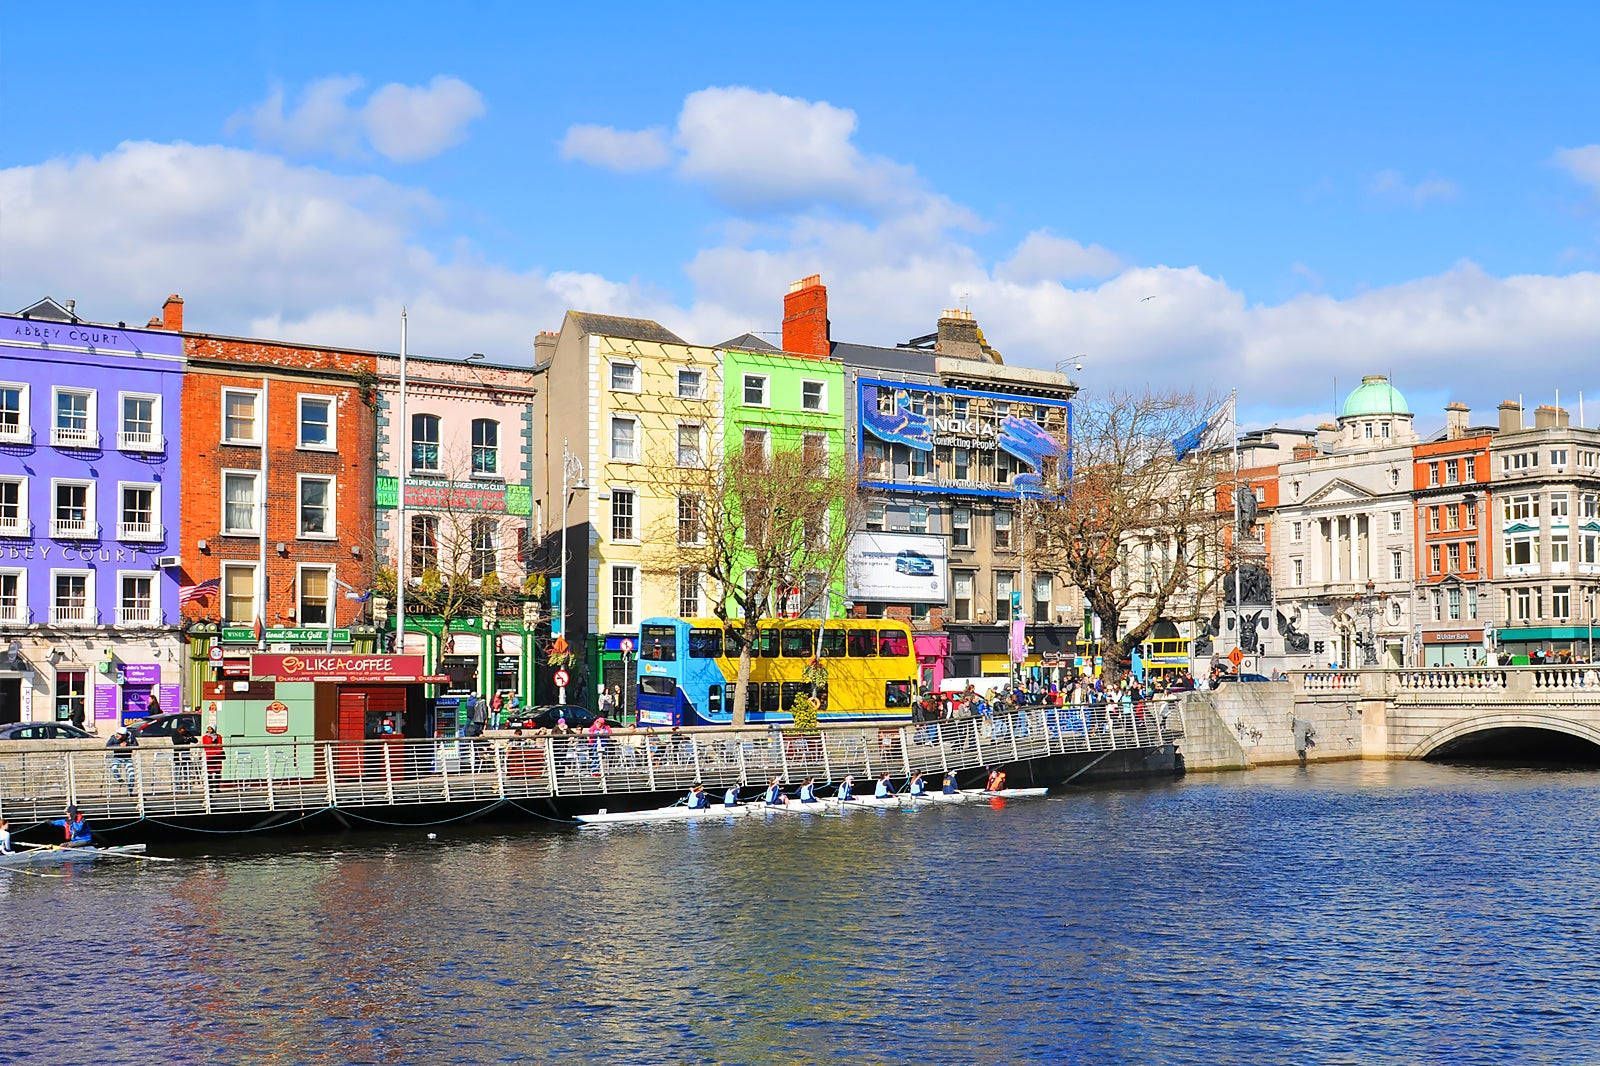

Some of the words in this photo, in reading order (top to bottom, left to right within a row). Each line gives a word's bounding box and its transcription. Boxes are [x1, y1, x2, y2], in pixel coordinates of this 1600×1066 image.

[15, 326, 59, 338] ABBEY
[69, 331, 118, 345] COURT
[933, 417, 994, 437] NOKIA
[933, 435, 971, 449] Connecting
[972, 438, 995, 451] People
[62, 546, 138, 563] COURT
